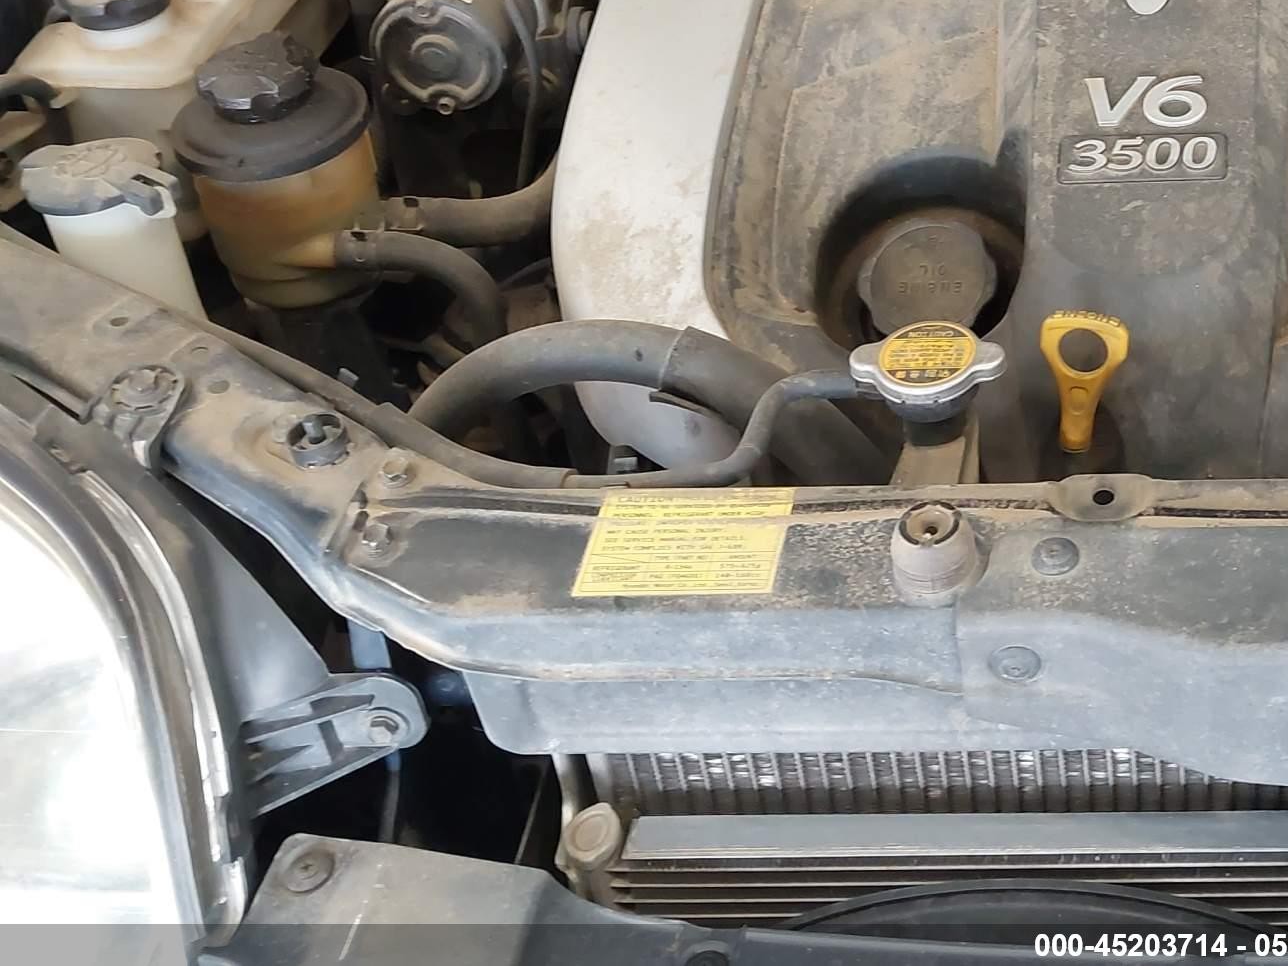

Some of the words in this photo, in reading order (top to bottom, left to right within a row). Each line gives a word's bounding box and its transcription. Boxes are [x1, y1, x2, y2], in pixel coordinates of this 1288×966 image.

[1083, 75, 1208, 127] V6
[1067, 136, 1218, 173] 3500
[919, 264, 945, 276] OIL
